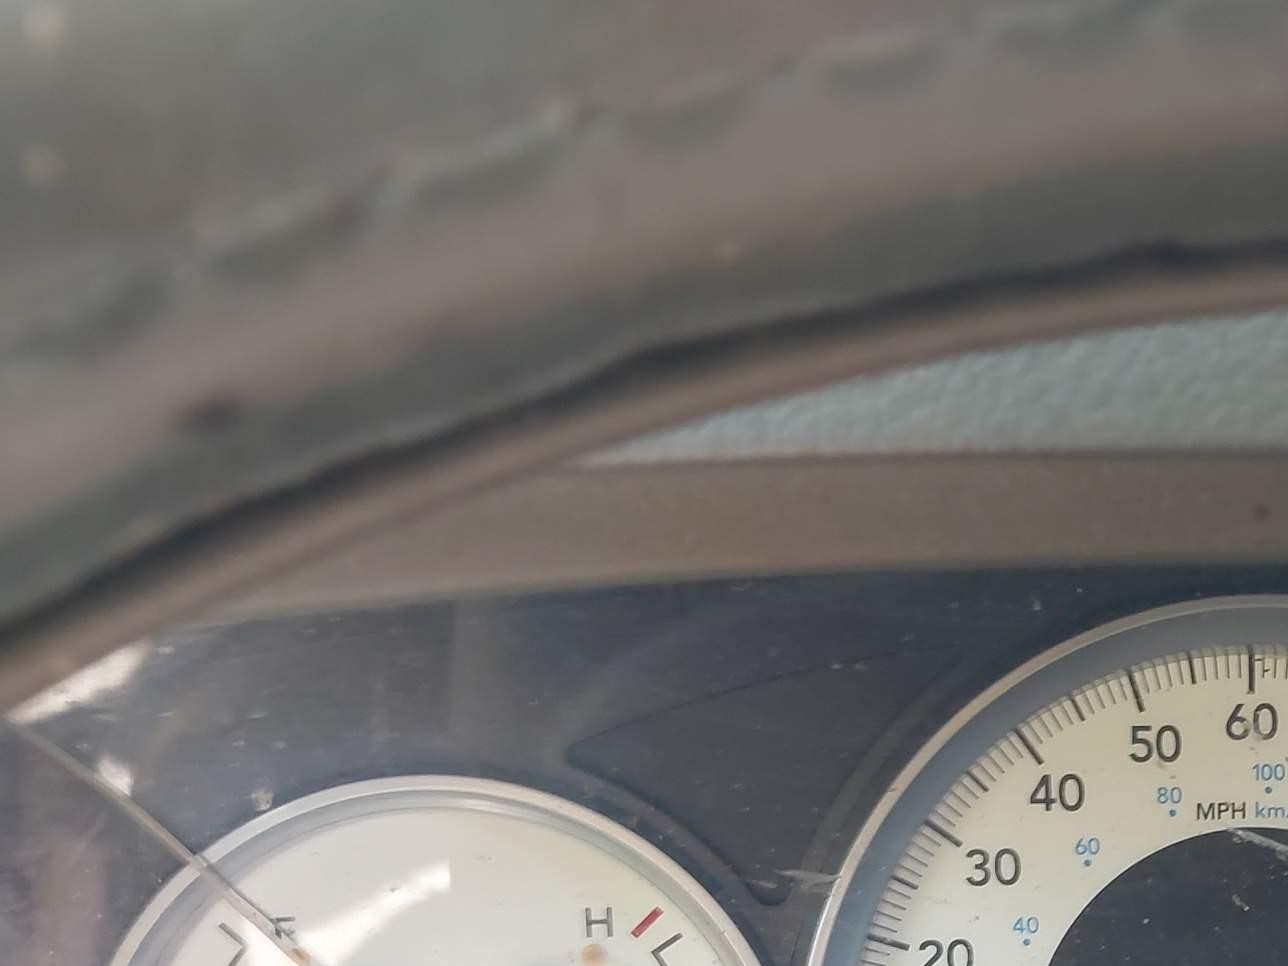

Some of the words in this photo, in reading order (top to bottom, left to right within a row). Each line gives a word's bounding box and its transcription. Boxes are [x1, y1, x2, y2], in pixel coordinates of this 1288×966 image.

[1225, 702, 1280, 741] 60
[1128, 725, 1182, 763] 50
[1251, 764, 1286, 783] 100
[1029, 774, 1086, 812] 40
[1156, 787, 1184, 805] 80
[1196, 803, 1247, 821] MPH
[1074, 838, 1101, 856] 60
[964, 848, 1022, 887] 30
[584, 907, 614, 938] H
[1012, 917, 1040, 935] 40
